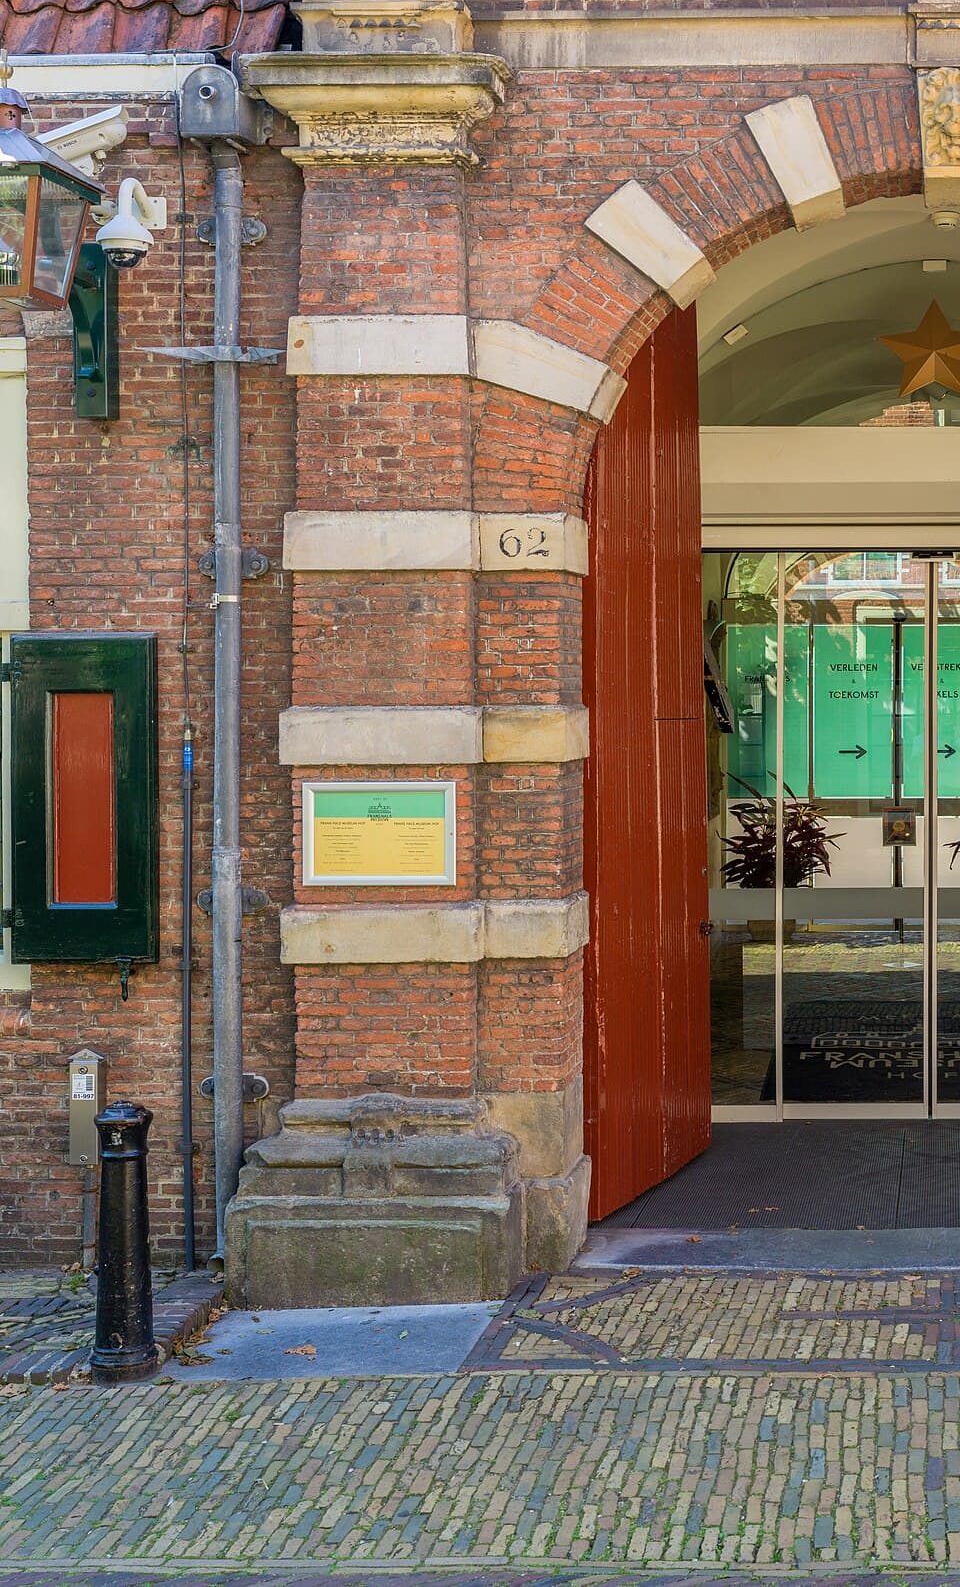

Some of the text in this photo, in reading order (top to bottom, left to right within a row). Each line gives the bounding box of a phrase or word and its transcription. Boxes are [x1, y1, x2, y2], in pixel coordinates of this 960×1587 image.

[500, 527, 549, 558] 62
[830, 663, 878, 672] VERLEDEN
[829, 690, 880, 699] TOEKOMST
